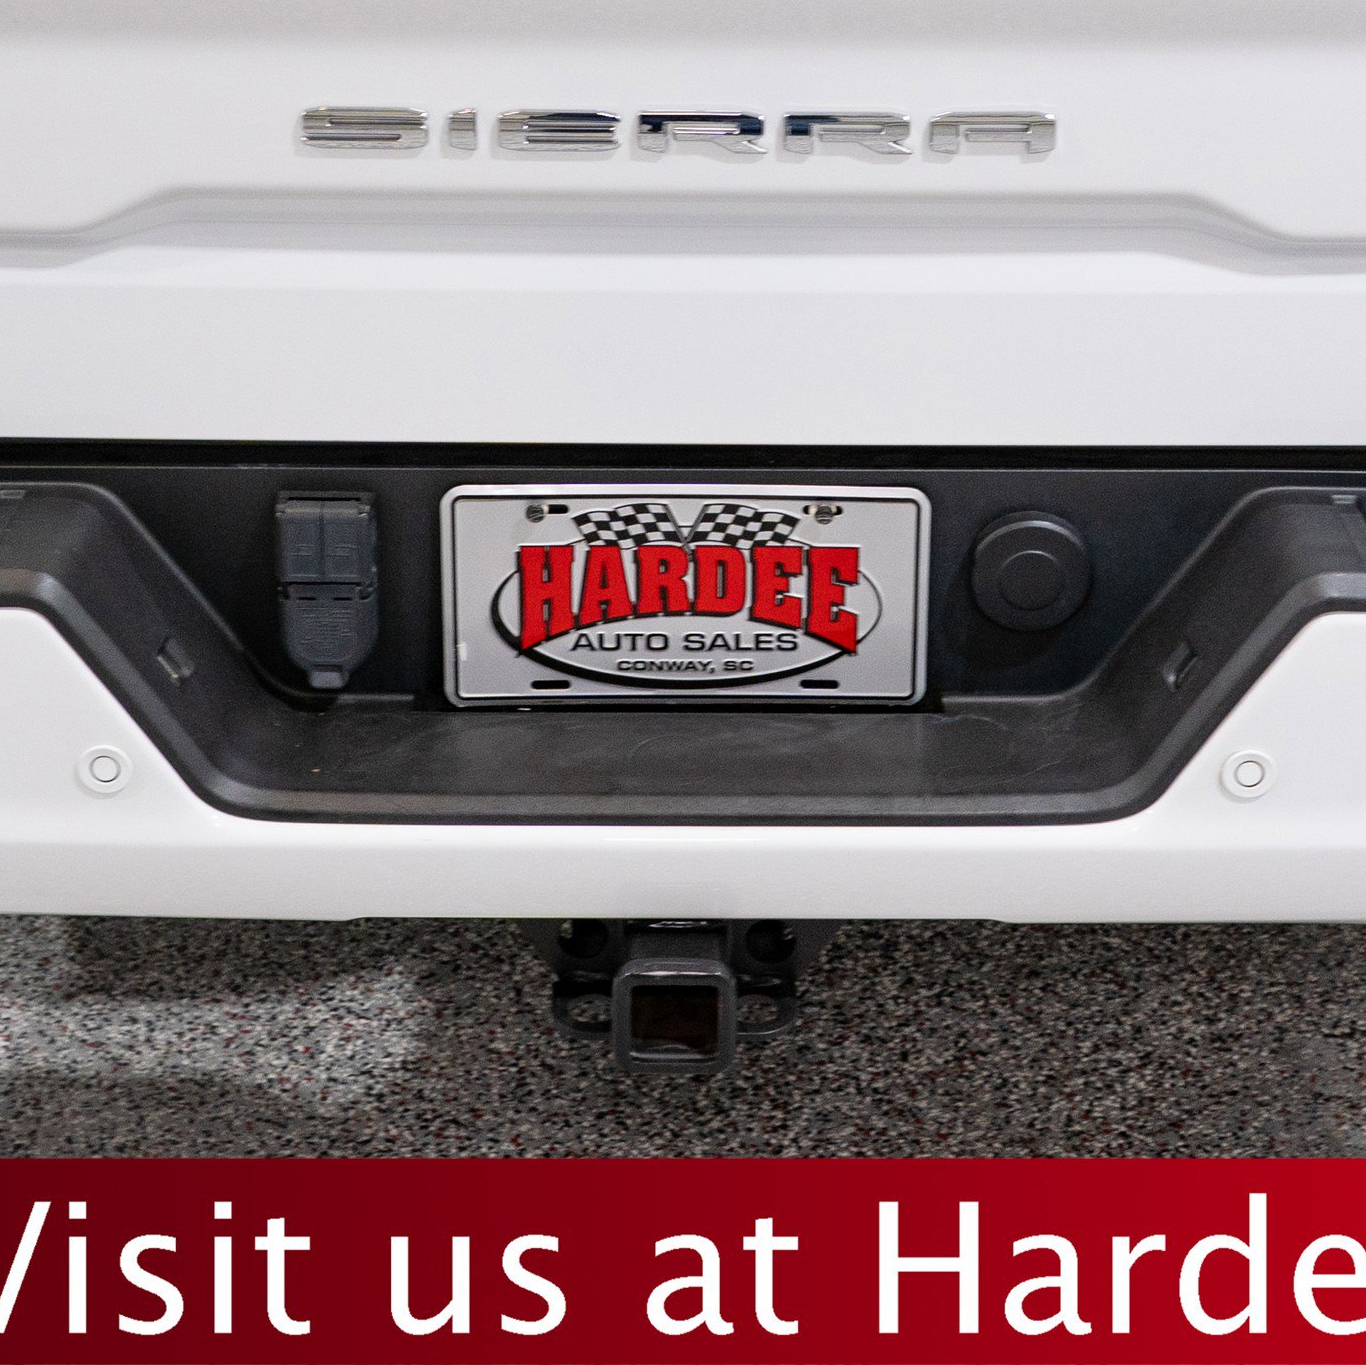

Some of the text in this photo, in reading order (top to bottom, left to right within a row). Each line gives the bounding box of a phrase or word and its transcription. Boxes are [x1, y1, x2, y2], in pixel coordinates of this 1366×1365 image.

[300, 105, 1059, 154] SIERRA
[517, 544, 861, 656] HARDEE
[570, 632, 799, 652] AUTO SALES
[617, 659, 755, 674] CONWAY, SC
